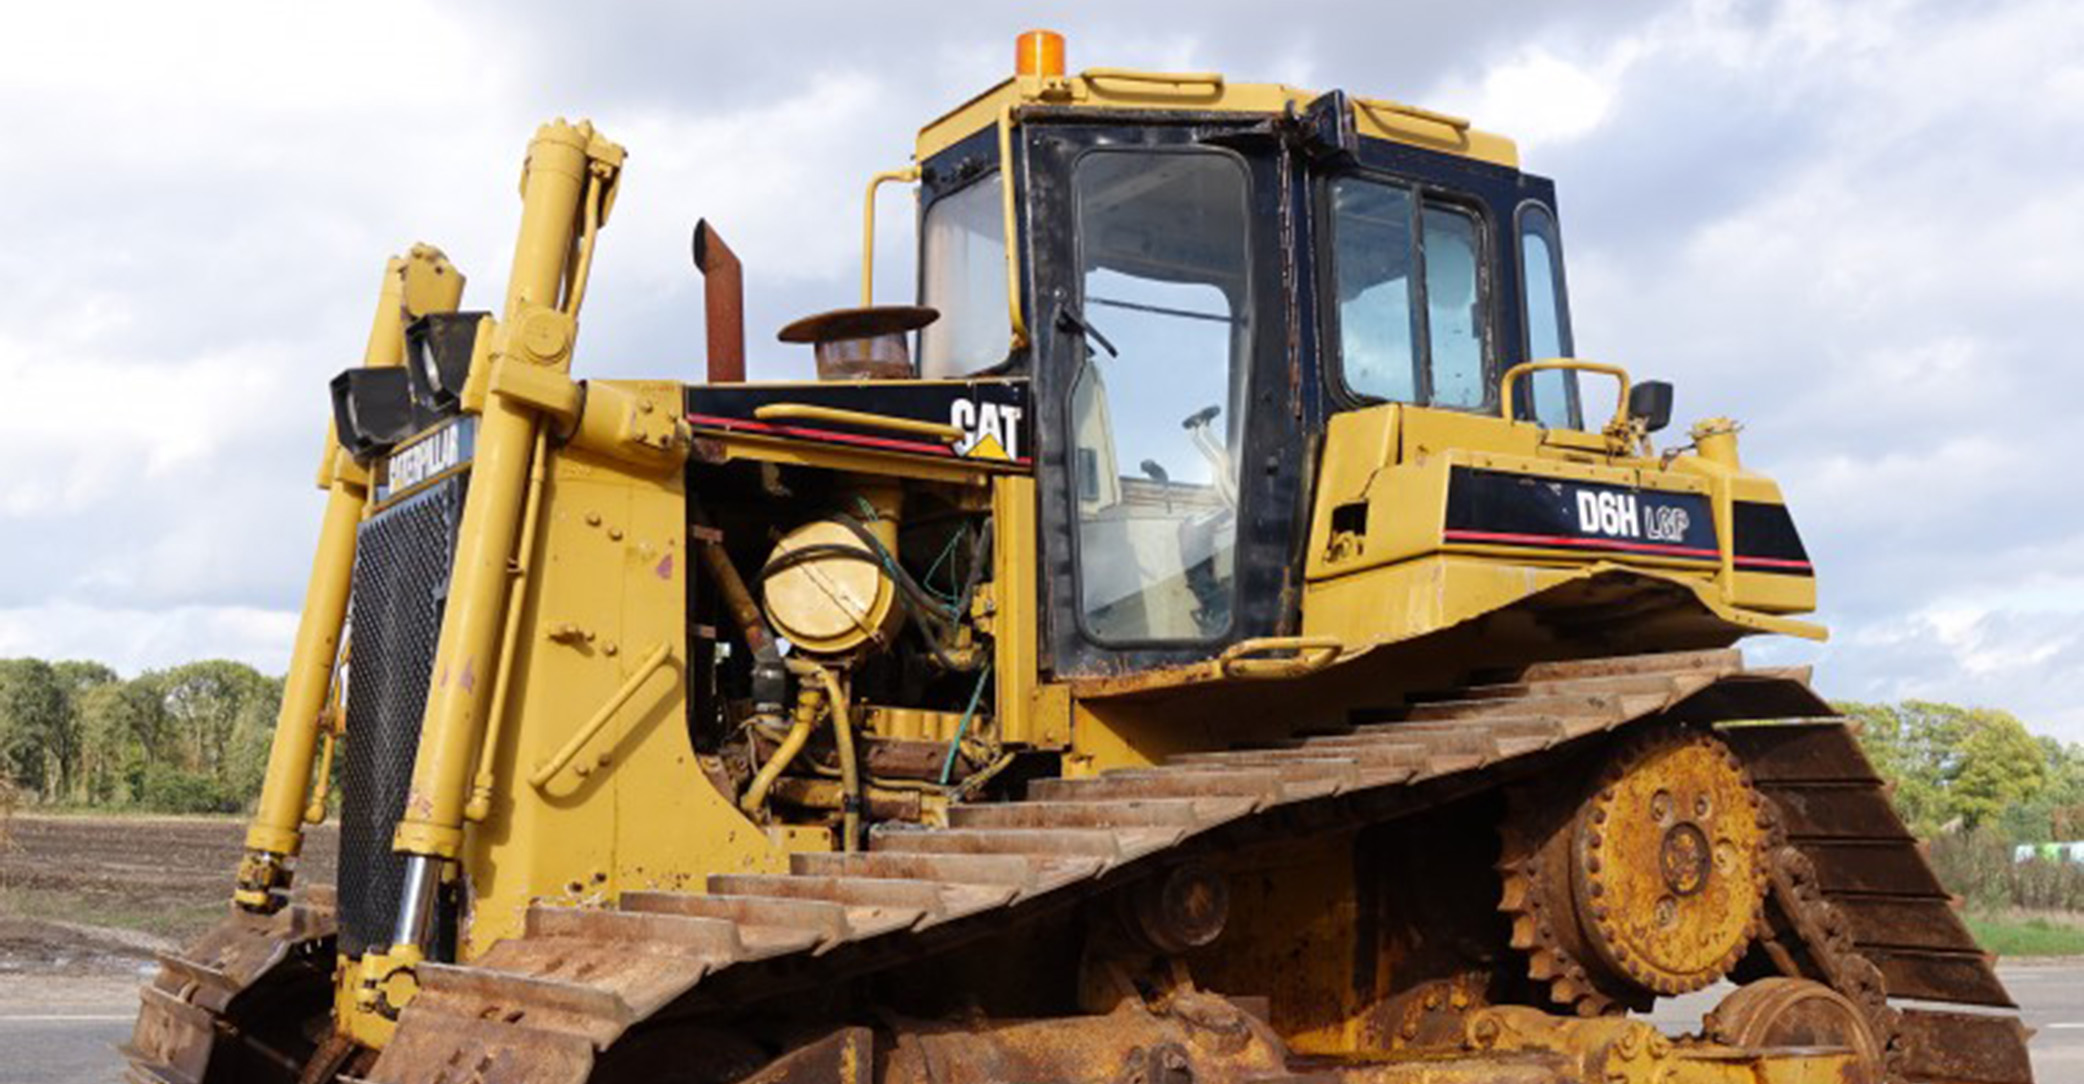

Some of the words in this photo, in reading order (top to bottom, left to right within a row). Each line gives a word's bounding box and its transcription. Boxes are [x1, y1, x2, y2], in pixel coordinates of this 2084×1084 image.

[388, 423, 459, 494] CATERPILLAR
[951, 398, 1022, 461] CAT
[1576, 489, 1640, 537] D6H
[1644, 505, 1690, 541] LGP
